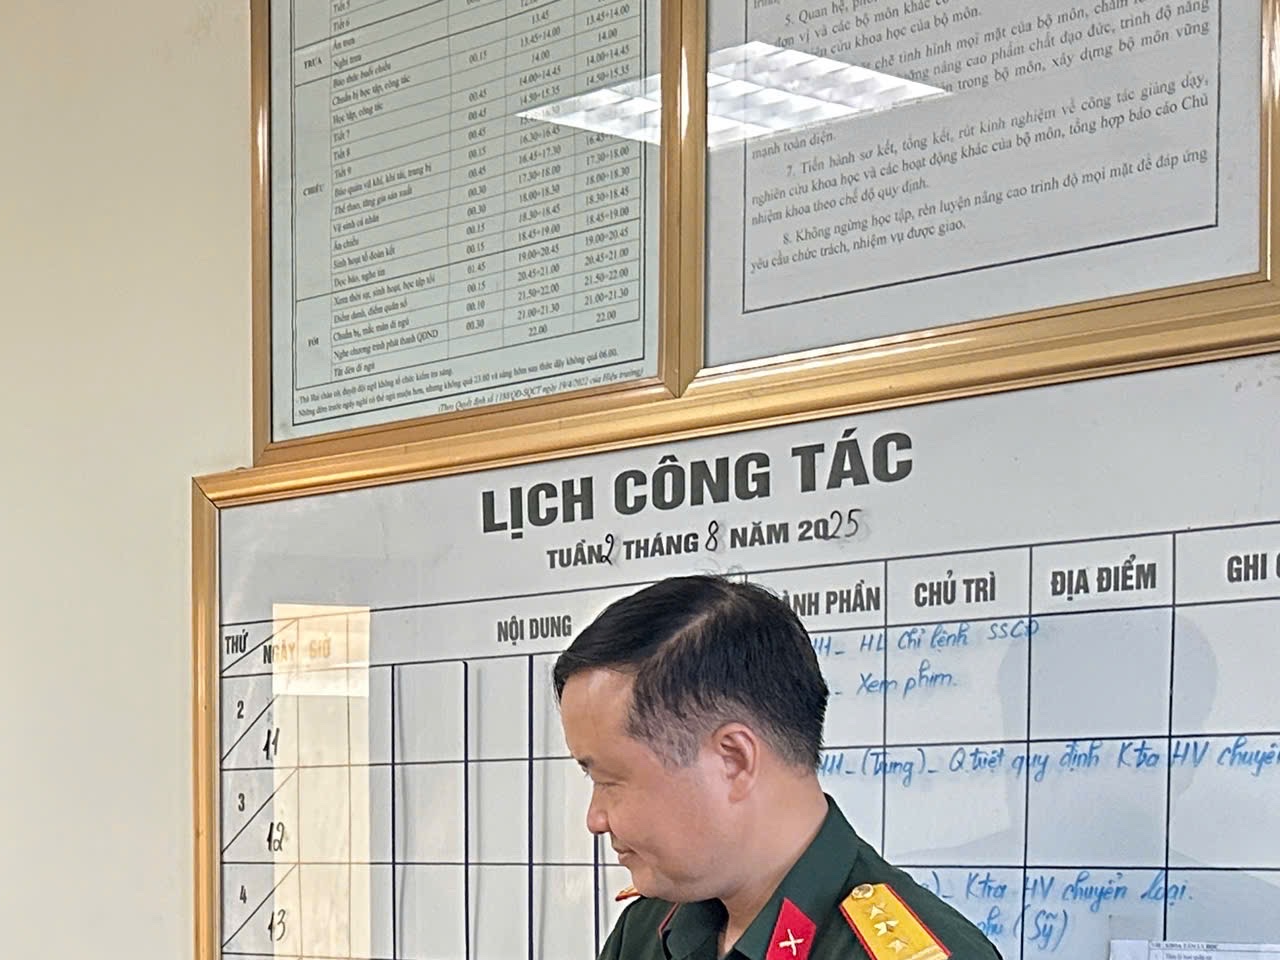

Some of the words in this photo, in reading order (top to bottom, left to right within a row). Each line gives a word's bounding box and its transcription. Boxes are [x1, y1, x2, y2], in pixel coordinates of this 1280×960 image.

[482, 477, 594, 539] LỊCH
[614, 452, 770, 516] CÔNG
[791, 427, 913, 493] TÁC
[547, 537, 601, 569] TUẦN
[623, 528, 699, 561] THÁNG
[705, 520, 719, 552] 8
[730, 520, 789, 550] NĂM
[1051, 568, 1089, 601] ĐỊA
[1096, 553, 1157, 593] ĐIỂM
[1227, 553, 1267, 583] GHI
[825, 579, 881, 614] PHẦN
[914, 570, 956, 607] CHỦ
[963, 571, 996, 603] TRÌ
[225, 629, 249, 655] THỨ
[497, 617, 526, 643] NỘI
[529, 615, 572, 641] DUNG
[237, 702, 244, 719] 2
[238, 794, 245, 812] 3
[266, 822, 285, 852] 12
[240, 886, 247, 903] 4
[267, 909, 287, 941] 13
